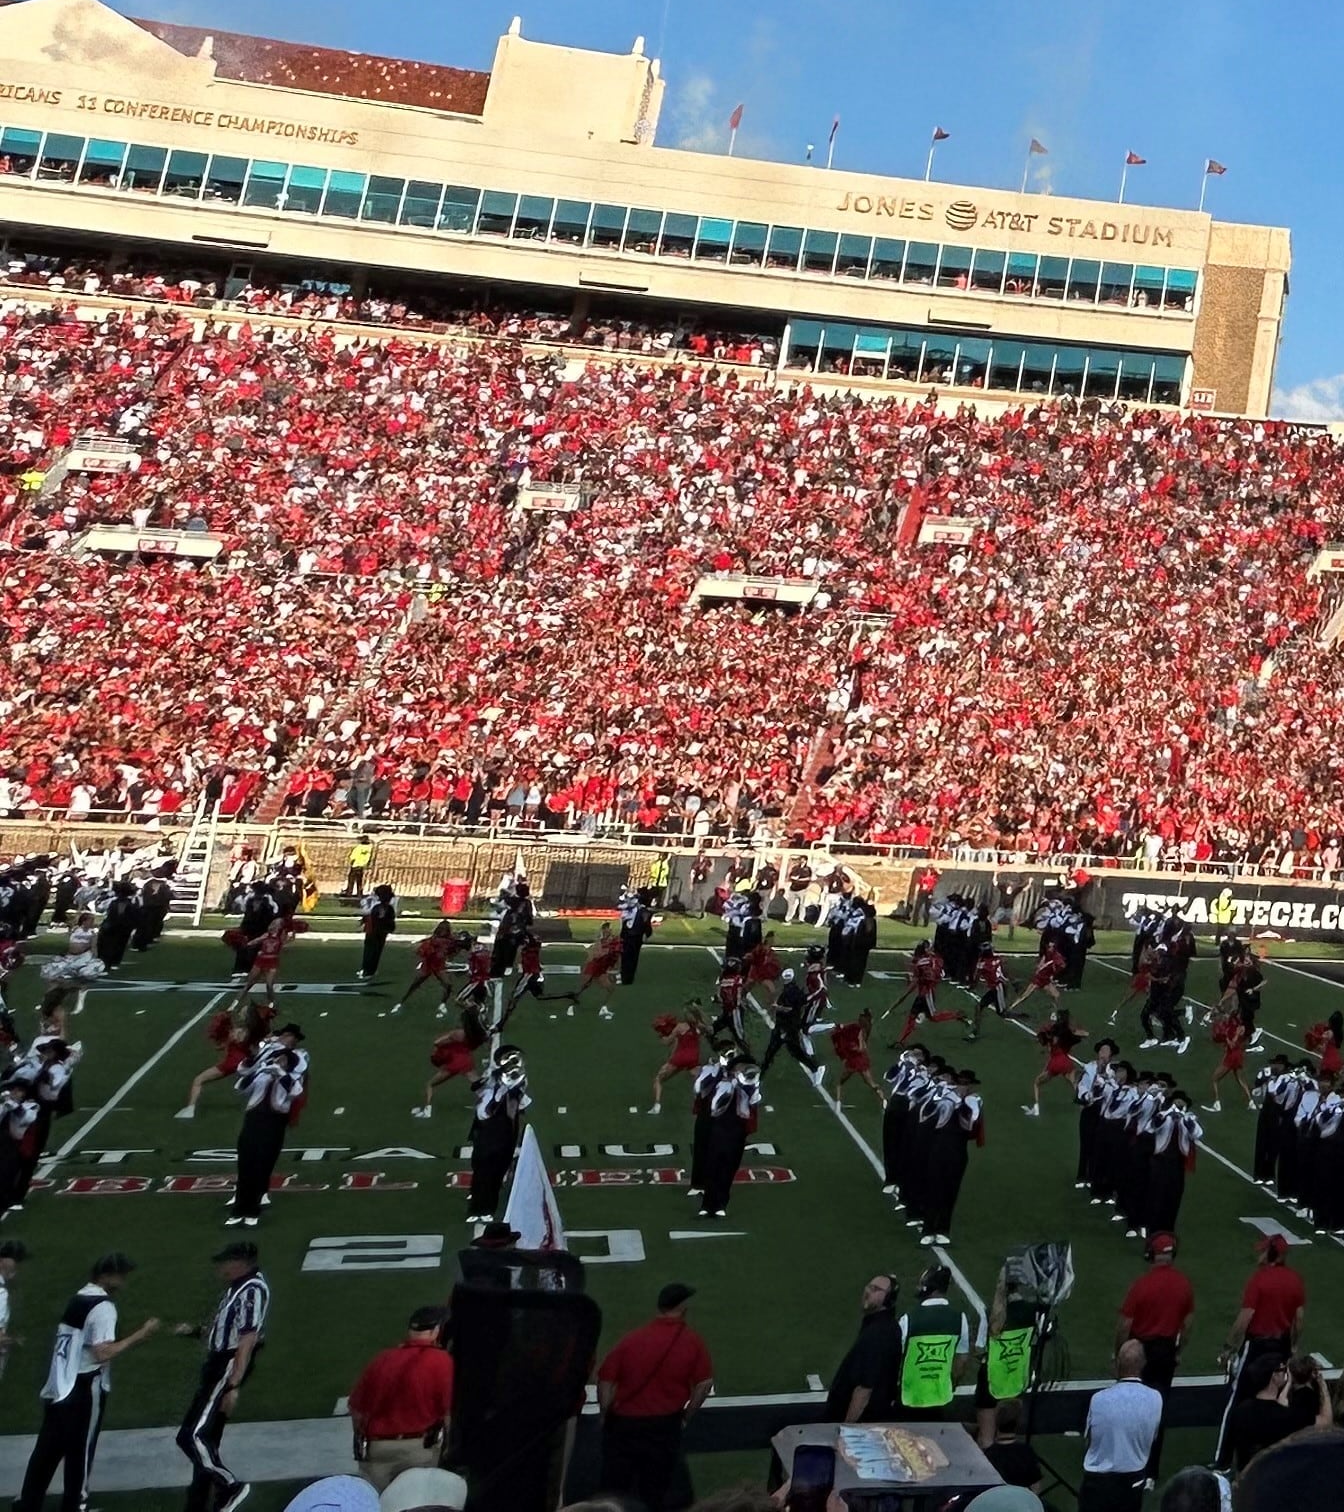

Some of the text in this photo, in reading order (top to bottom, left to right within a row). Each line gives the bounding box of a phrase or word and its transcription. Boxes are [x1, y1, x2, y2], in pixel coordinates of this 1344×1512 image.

[0, 83, 62, 105] ICANS
[104, 98, 214, 127] CONFERENCE
[218, 115, 360, 146] CHAMPIONSHIPS
[836, 191, 1174, 248] JONES AT&T STADIUM
